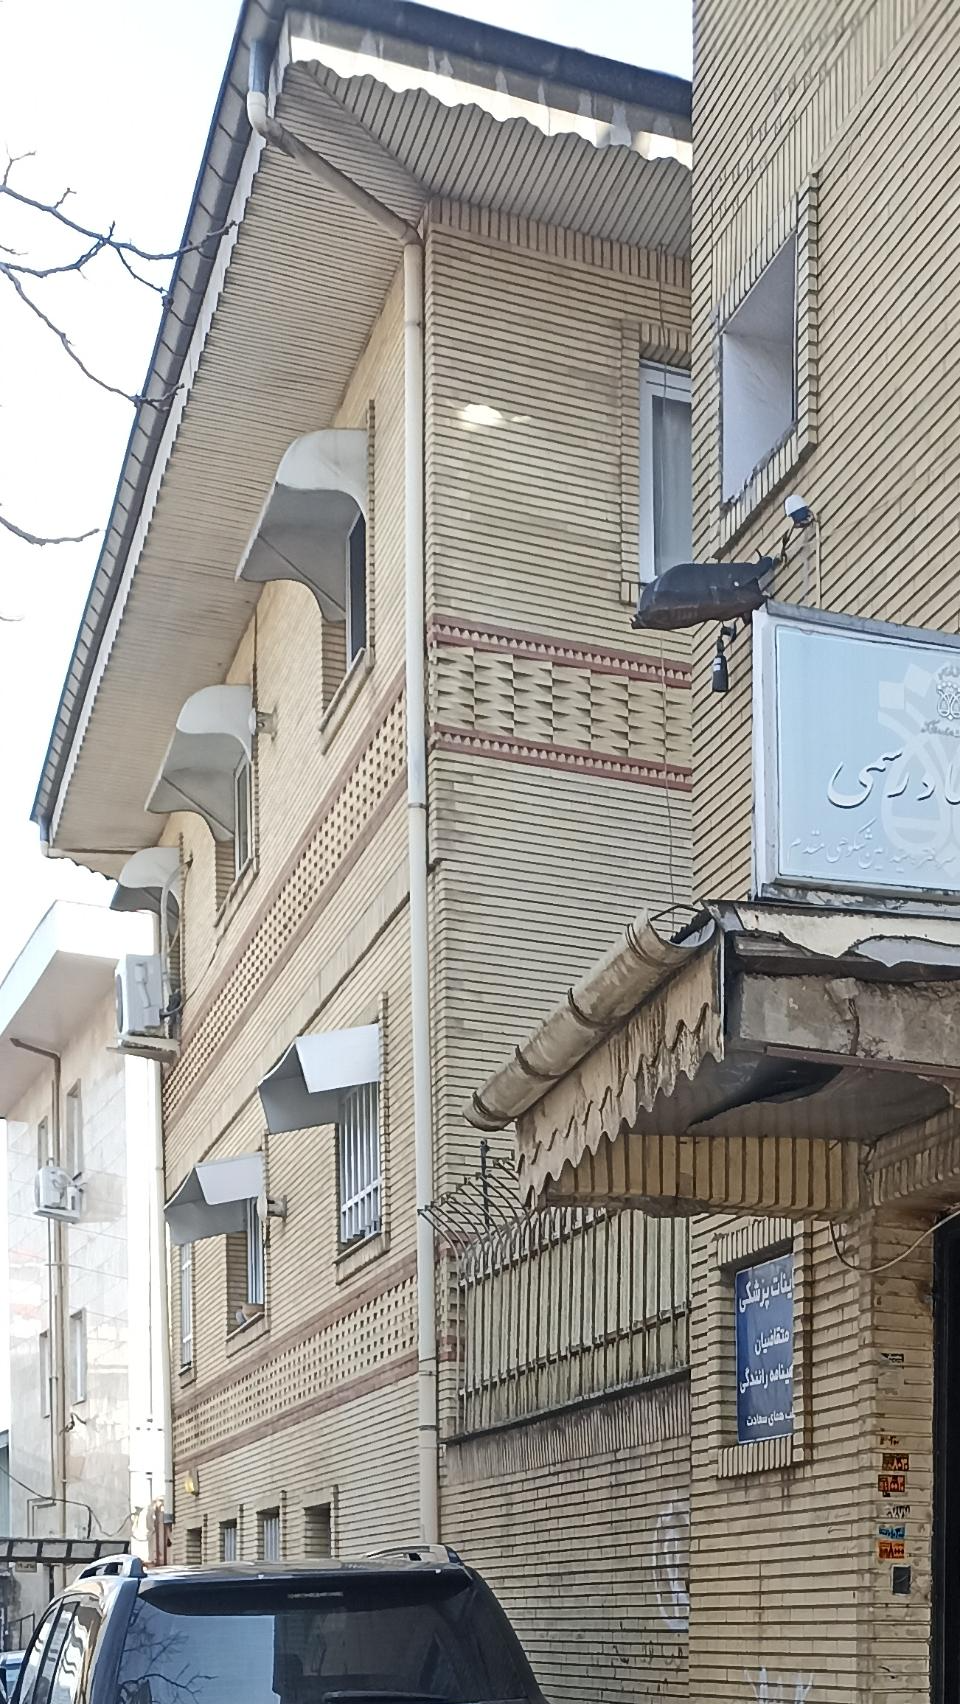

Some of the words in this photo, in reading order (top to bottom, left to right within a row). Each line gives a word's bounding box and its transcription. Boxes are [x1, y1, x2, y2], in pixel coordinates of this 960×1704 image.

[827, 752, 909, 809] رسمی
[740, 1279, 770, 1313] پزشکی
[754, 1326, 790, 1356] متقاضیان
[740, 1367, 769, 1394] رانندگی
